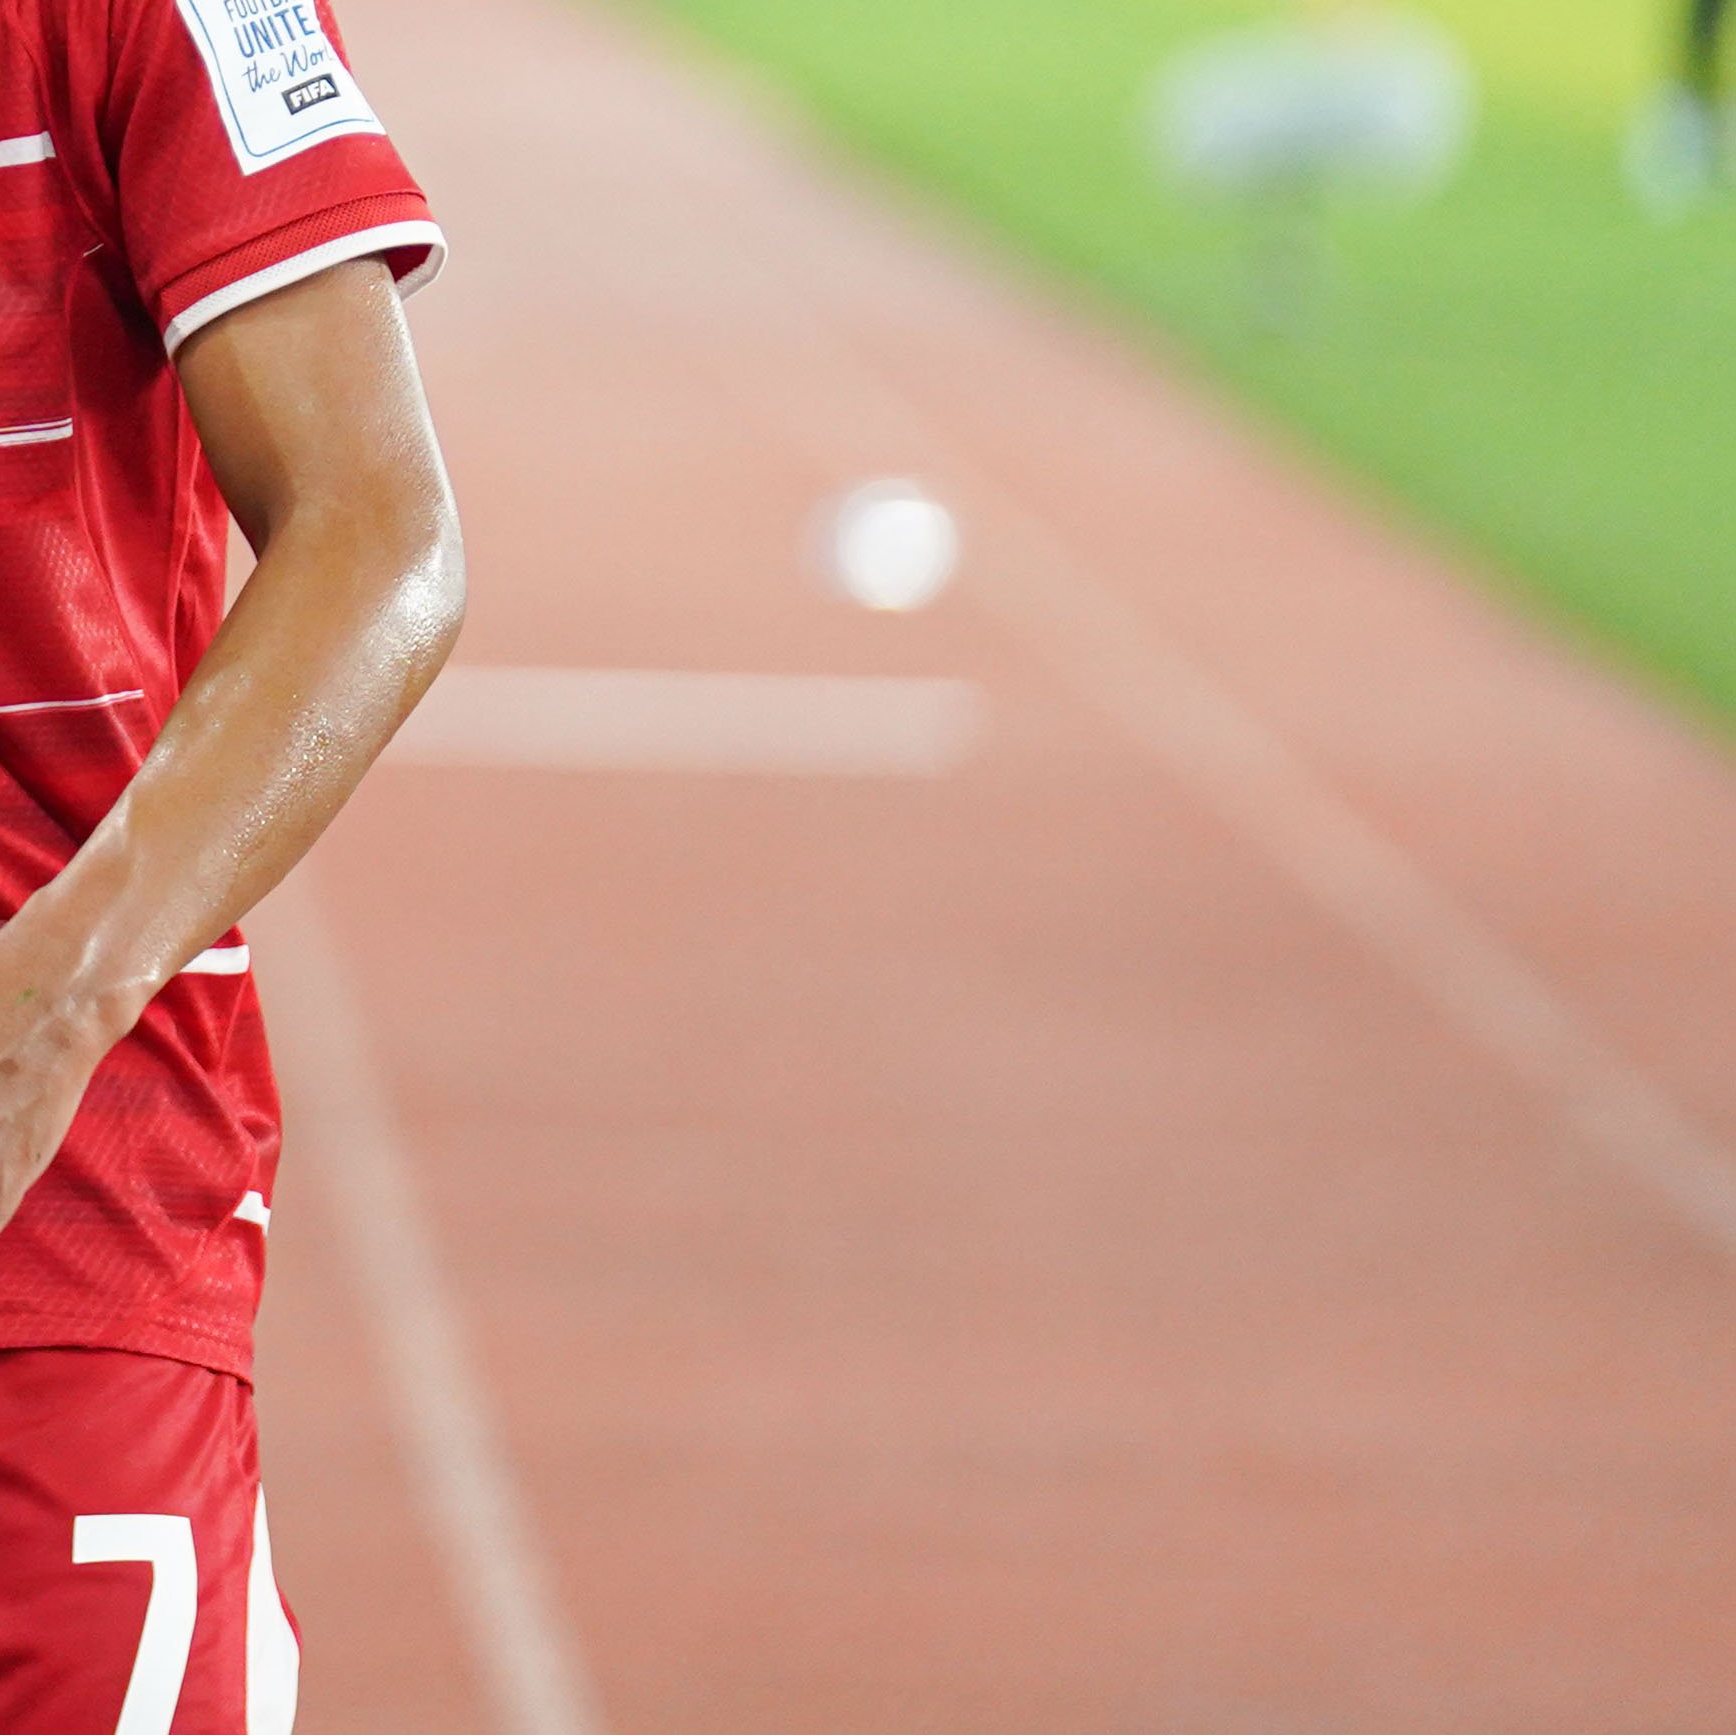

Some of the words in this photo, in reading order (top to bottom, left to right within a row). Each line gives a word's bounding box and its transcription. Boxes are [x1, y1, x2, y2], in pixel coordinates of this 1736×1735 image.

[233, 4, 316, 58] UNITE
[241, 60, 281, 93] the
[289, 79, 336, 108] FIFA
[72, 1513, 198, 1735] 7
